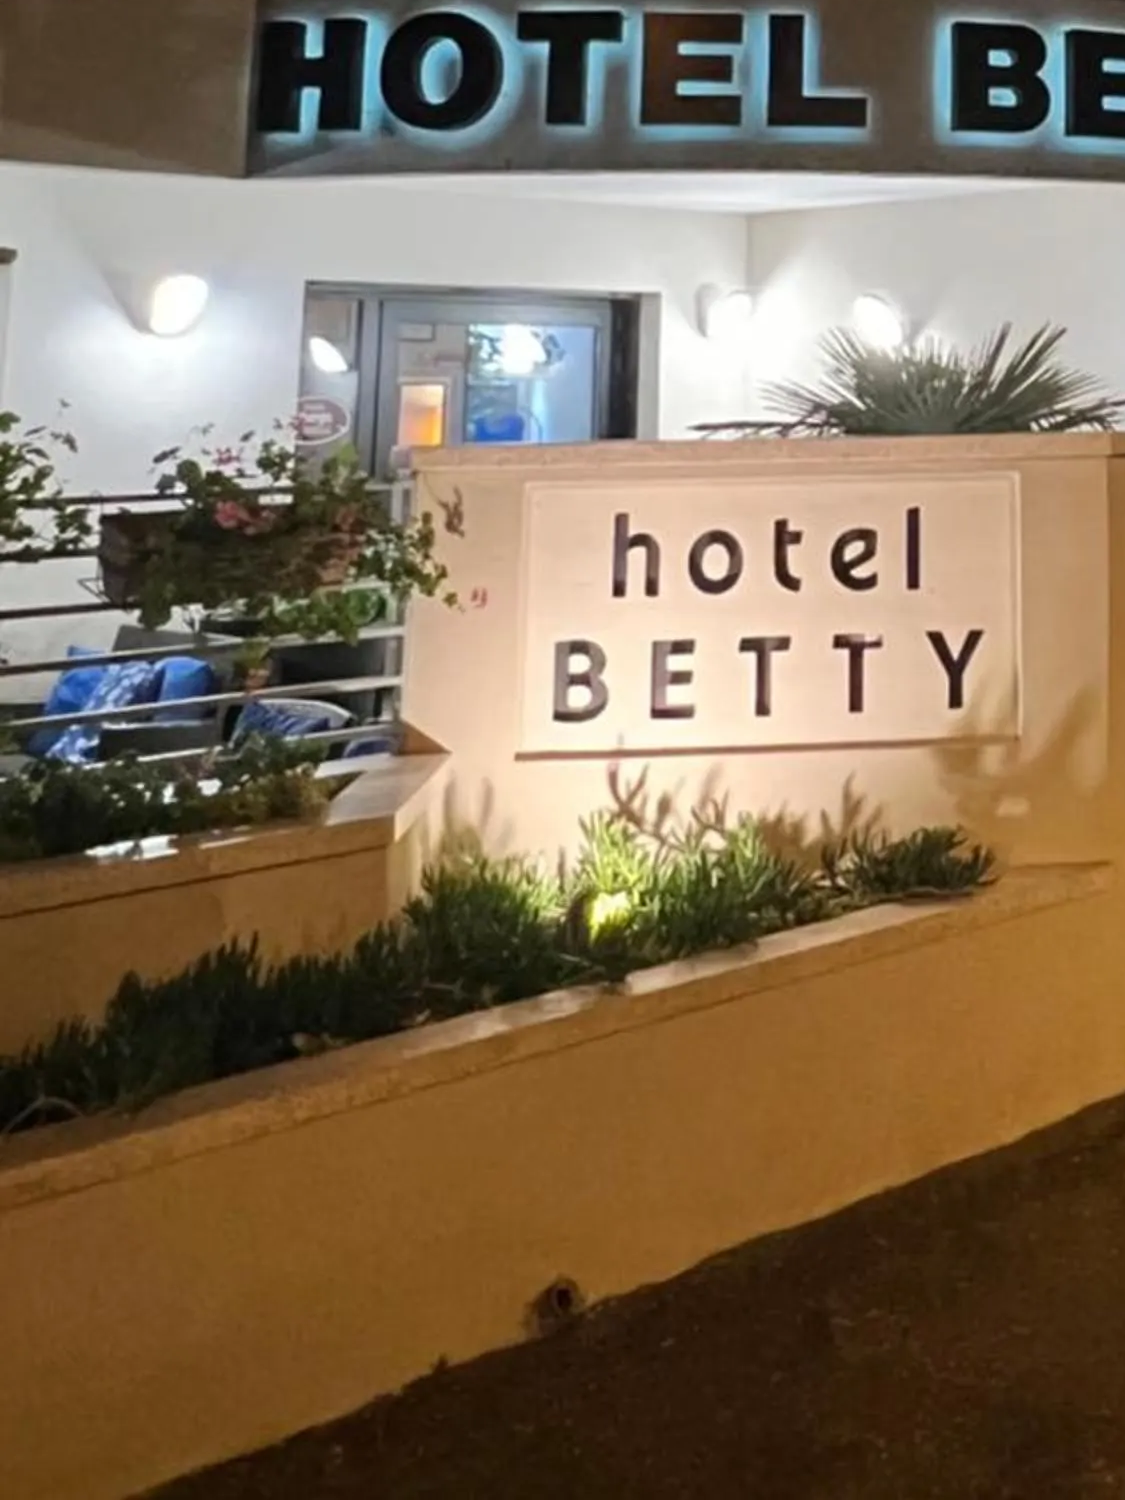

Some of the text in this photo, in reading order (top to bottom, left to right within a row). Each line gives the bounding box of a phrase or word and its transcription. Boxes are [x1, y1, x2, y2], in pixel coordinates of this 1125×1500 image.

[257, 10, 869, 133] HOTEL
[611, 505, 921, 598] hotel
[552, 629, 985, 723] BETTY
